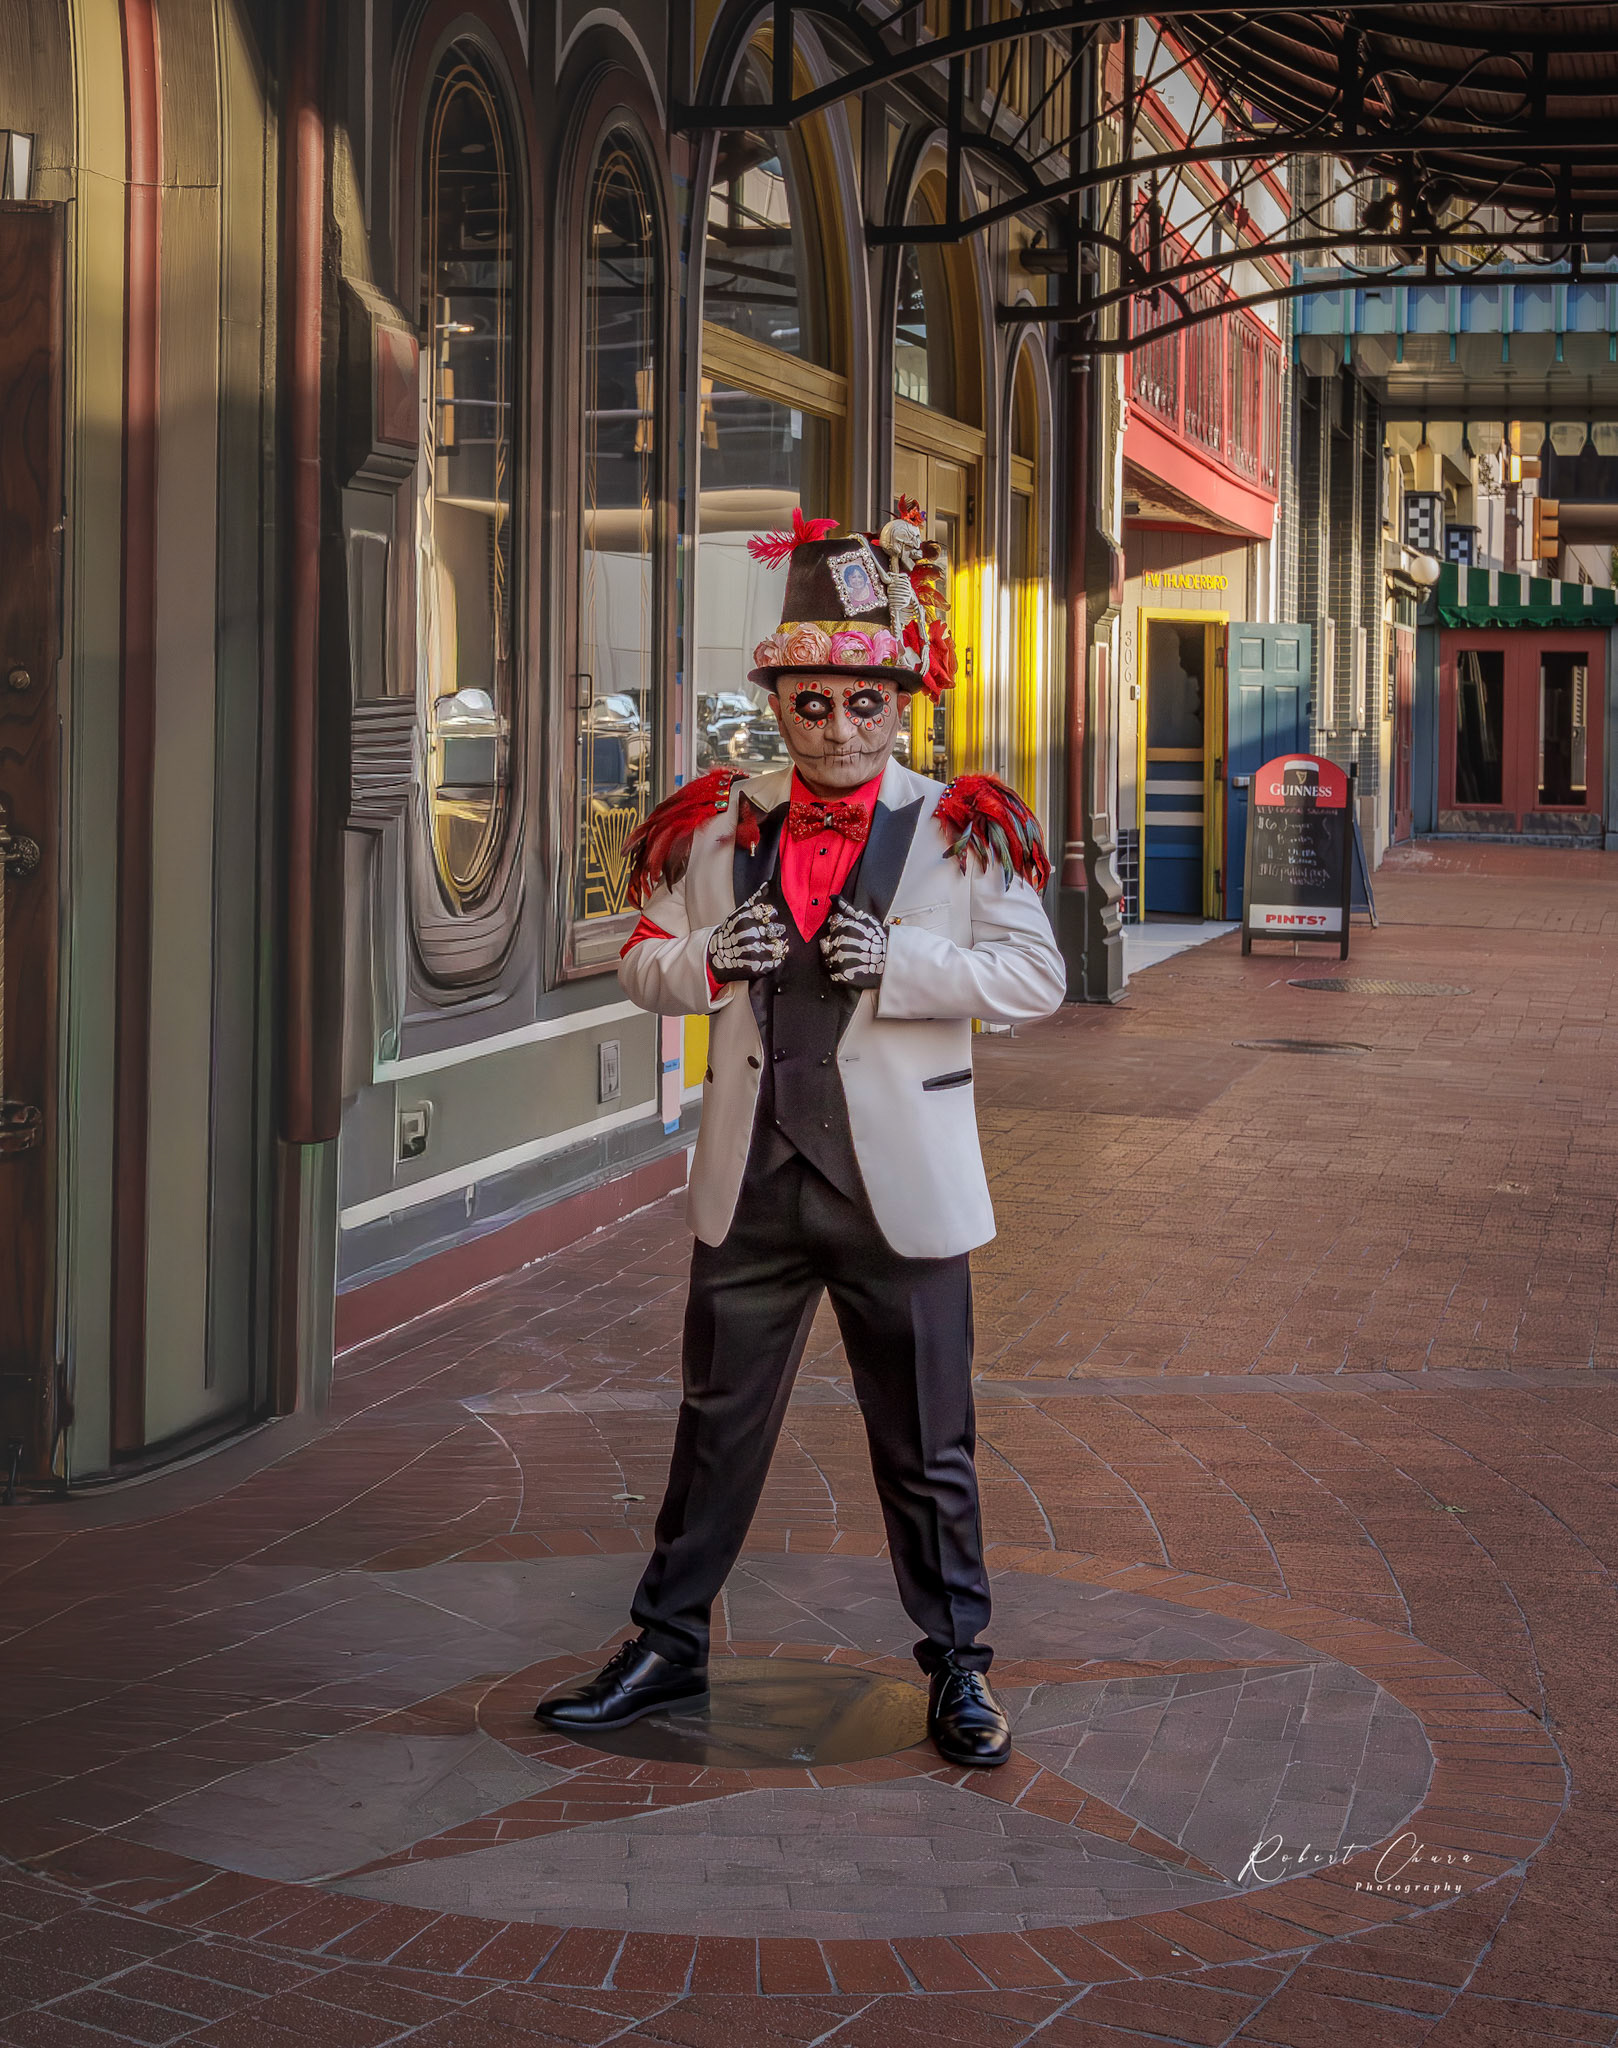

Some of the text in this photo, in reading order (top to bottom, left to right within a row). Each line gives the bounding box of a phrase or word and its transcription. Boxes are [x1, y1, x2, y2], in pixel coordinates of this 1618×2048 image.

[1145, 571, 1229, 590] FW THUNDERBIRD
[1124, 630, 1133, 683] 306
[1269, 782, 1332, 798] GUINNESS
[1265, 914, 1327, 926] PINTS?
